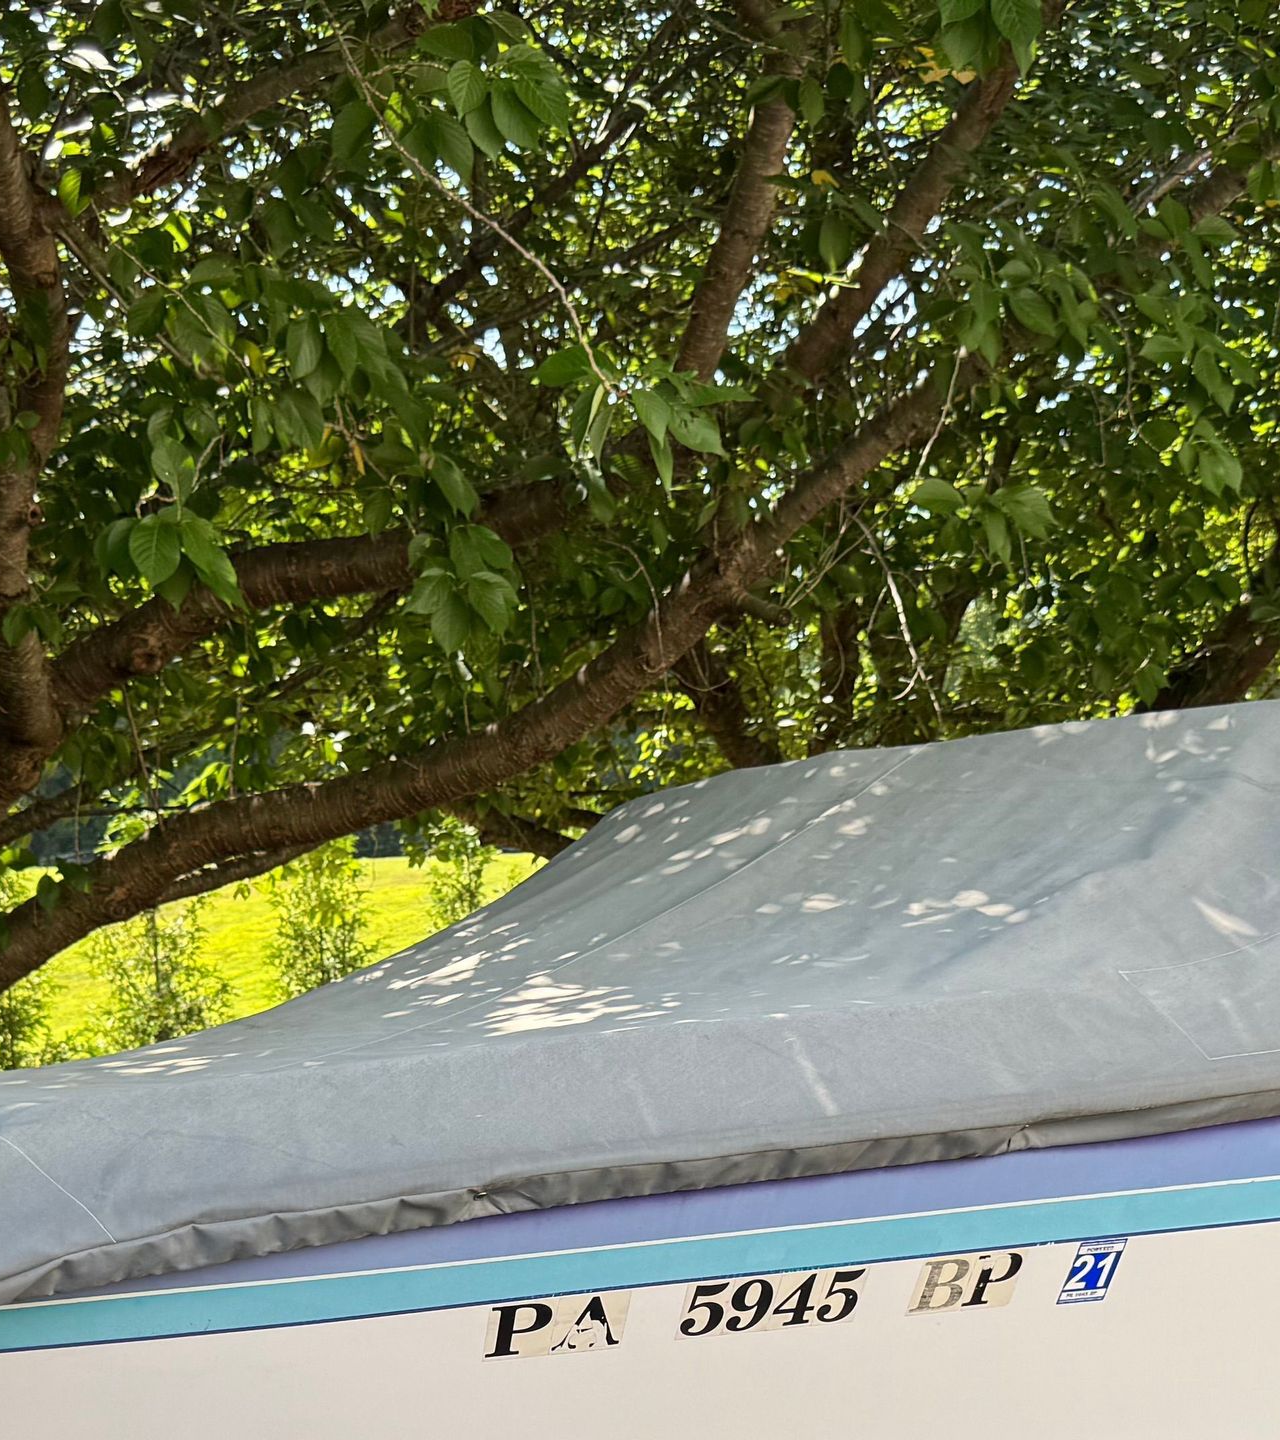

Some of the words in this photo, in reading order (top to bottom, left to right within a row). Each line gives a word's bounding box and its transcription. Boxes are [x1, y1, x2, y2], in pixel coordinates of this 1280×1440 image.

[484, 1296, 619, 1358] PA
[680, 1269, 865, 1336] 5945
[909, 1253, 1023, 1312] BP
[1063, 1252, 1116, 1290] 21
